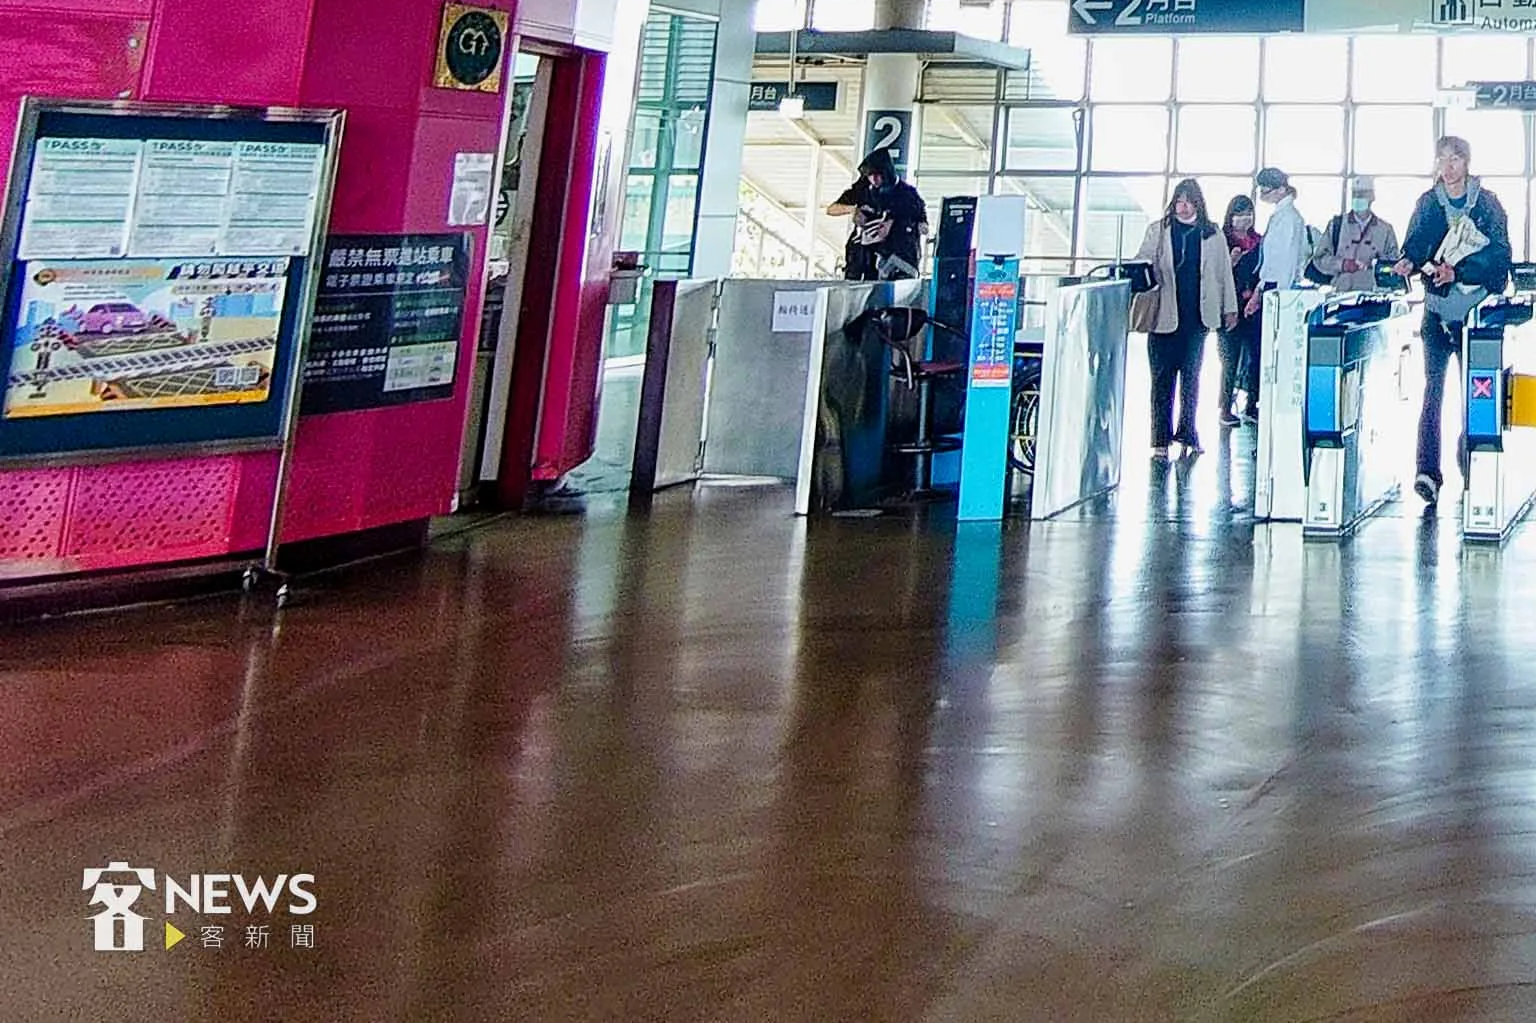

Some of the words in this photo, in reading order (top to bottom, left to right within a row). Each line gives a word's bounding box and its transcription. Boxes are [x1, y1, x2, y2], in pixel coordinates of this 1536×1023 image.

[1145, 12, 1196, 25] Platform
[751, 86, 777, 100] 月台
[873, 116, 902, 158] 2
[1319, 503, 1327, 512] 3
[1473, 506, 1481, 515] 3
